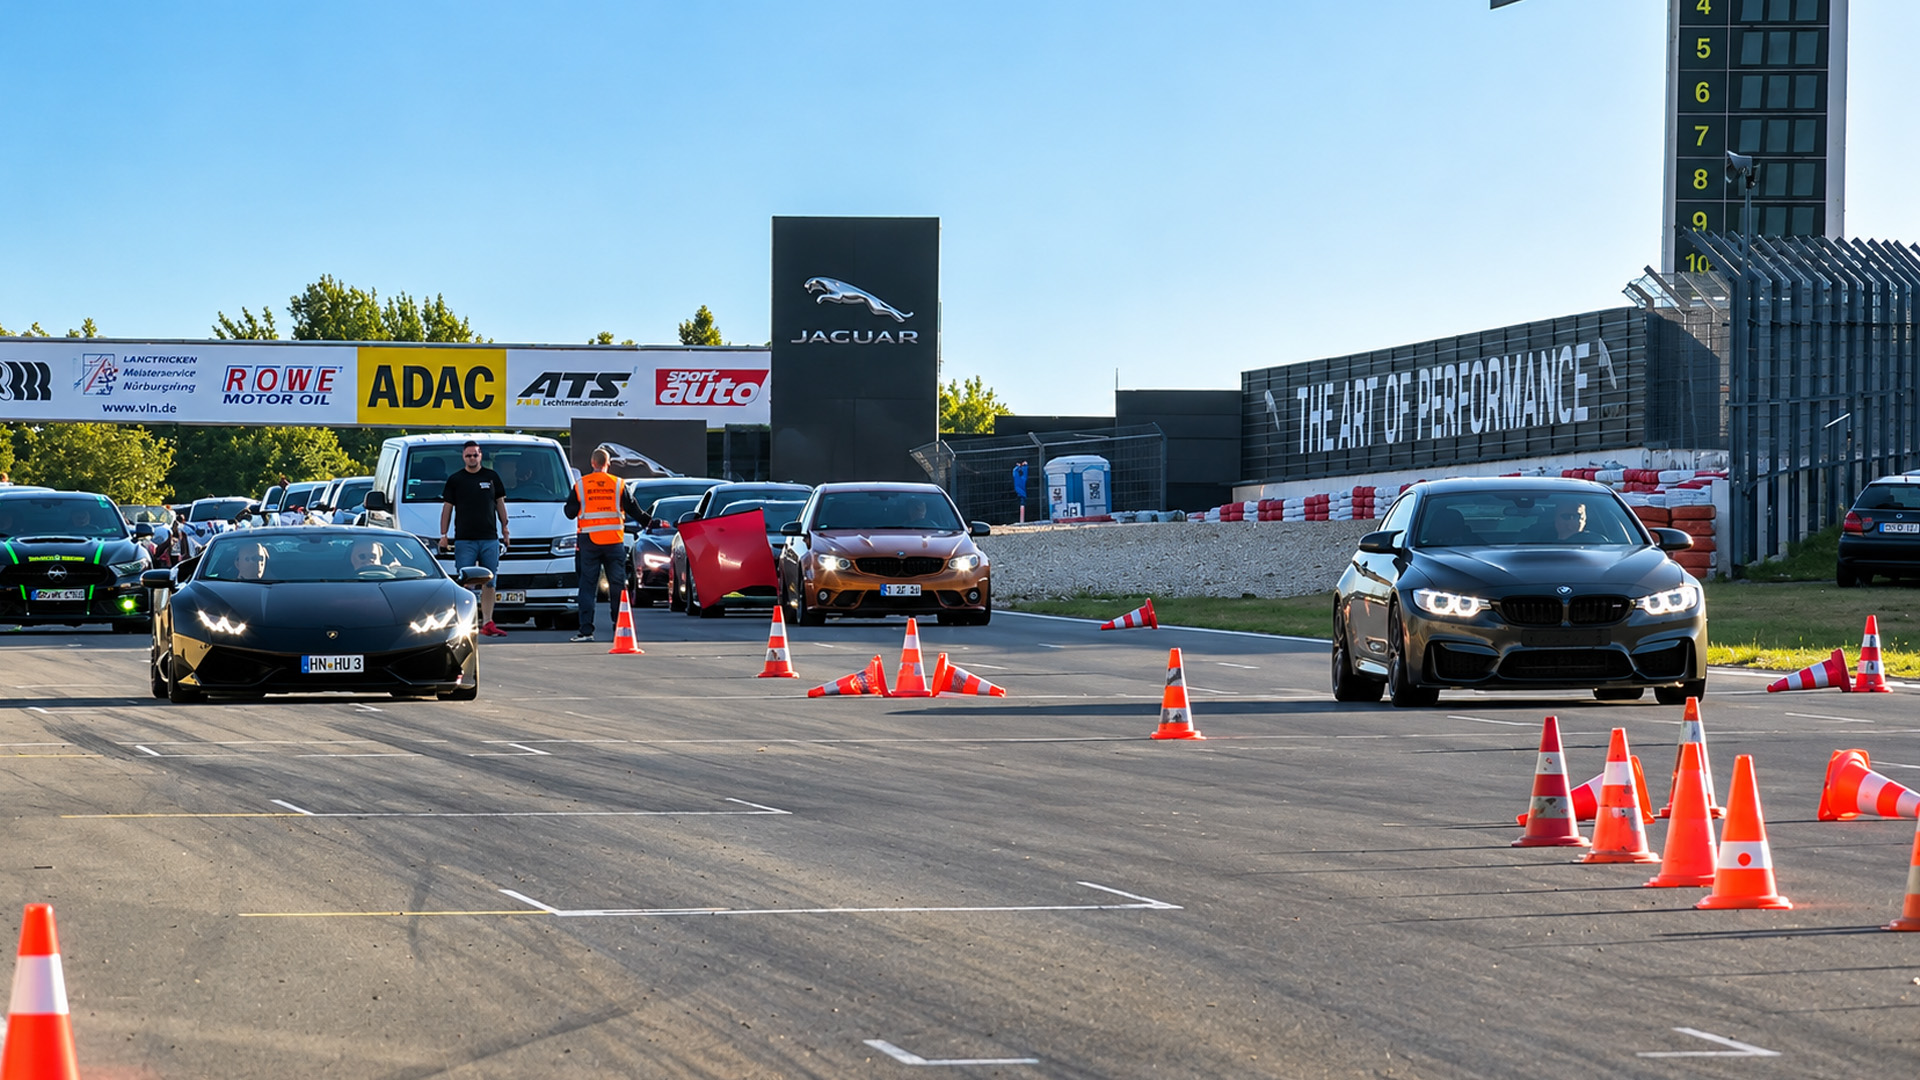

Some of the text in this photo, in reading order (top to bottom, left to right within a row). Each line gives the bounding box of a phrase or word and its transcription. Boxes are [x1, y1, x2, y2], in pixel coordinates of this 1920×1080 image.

[1696, 0, 1711, 14] 4
[1697, 38, 1711, 58] 5
[1696, 81, 1710, 103] 6
[1695, 125, 1709, 146] 7
[1693, 168, 1708, 190] 8
[1692, 211, 1707, 231] 9
[1685, 253, 1709, 273] 10
[791, 330, 918, 344] JAGUAR
[226, 367, 337, 392] ROWE
[517, 371, 633, 399] ATS
[667, 370, 720, 382] sport
[367, 365, 495, 410] ADAC
[659, 378, 760, 404] auto
[223, 393, 330, 406] MOTOR OIL
[1297, 342, 1590, 454] THE ART OF PERFORMANCE
[102, 403, 177, 414] www.vln.de
[310, 657, 362, 671] HN HU 3
